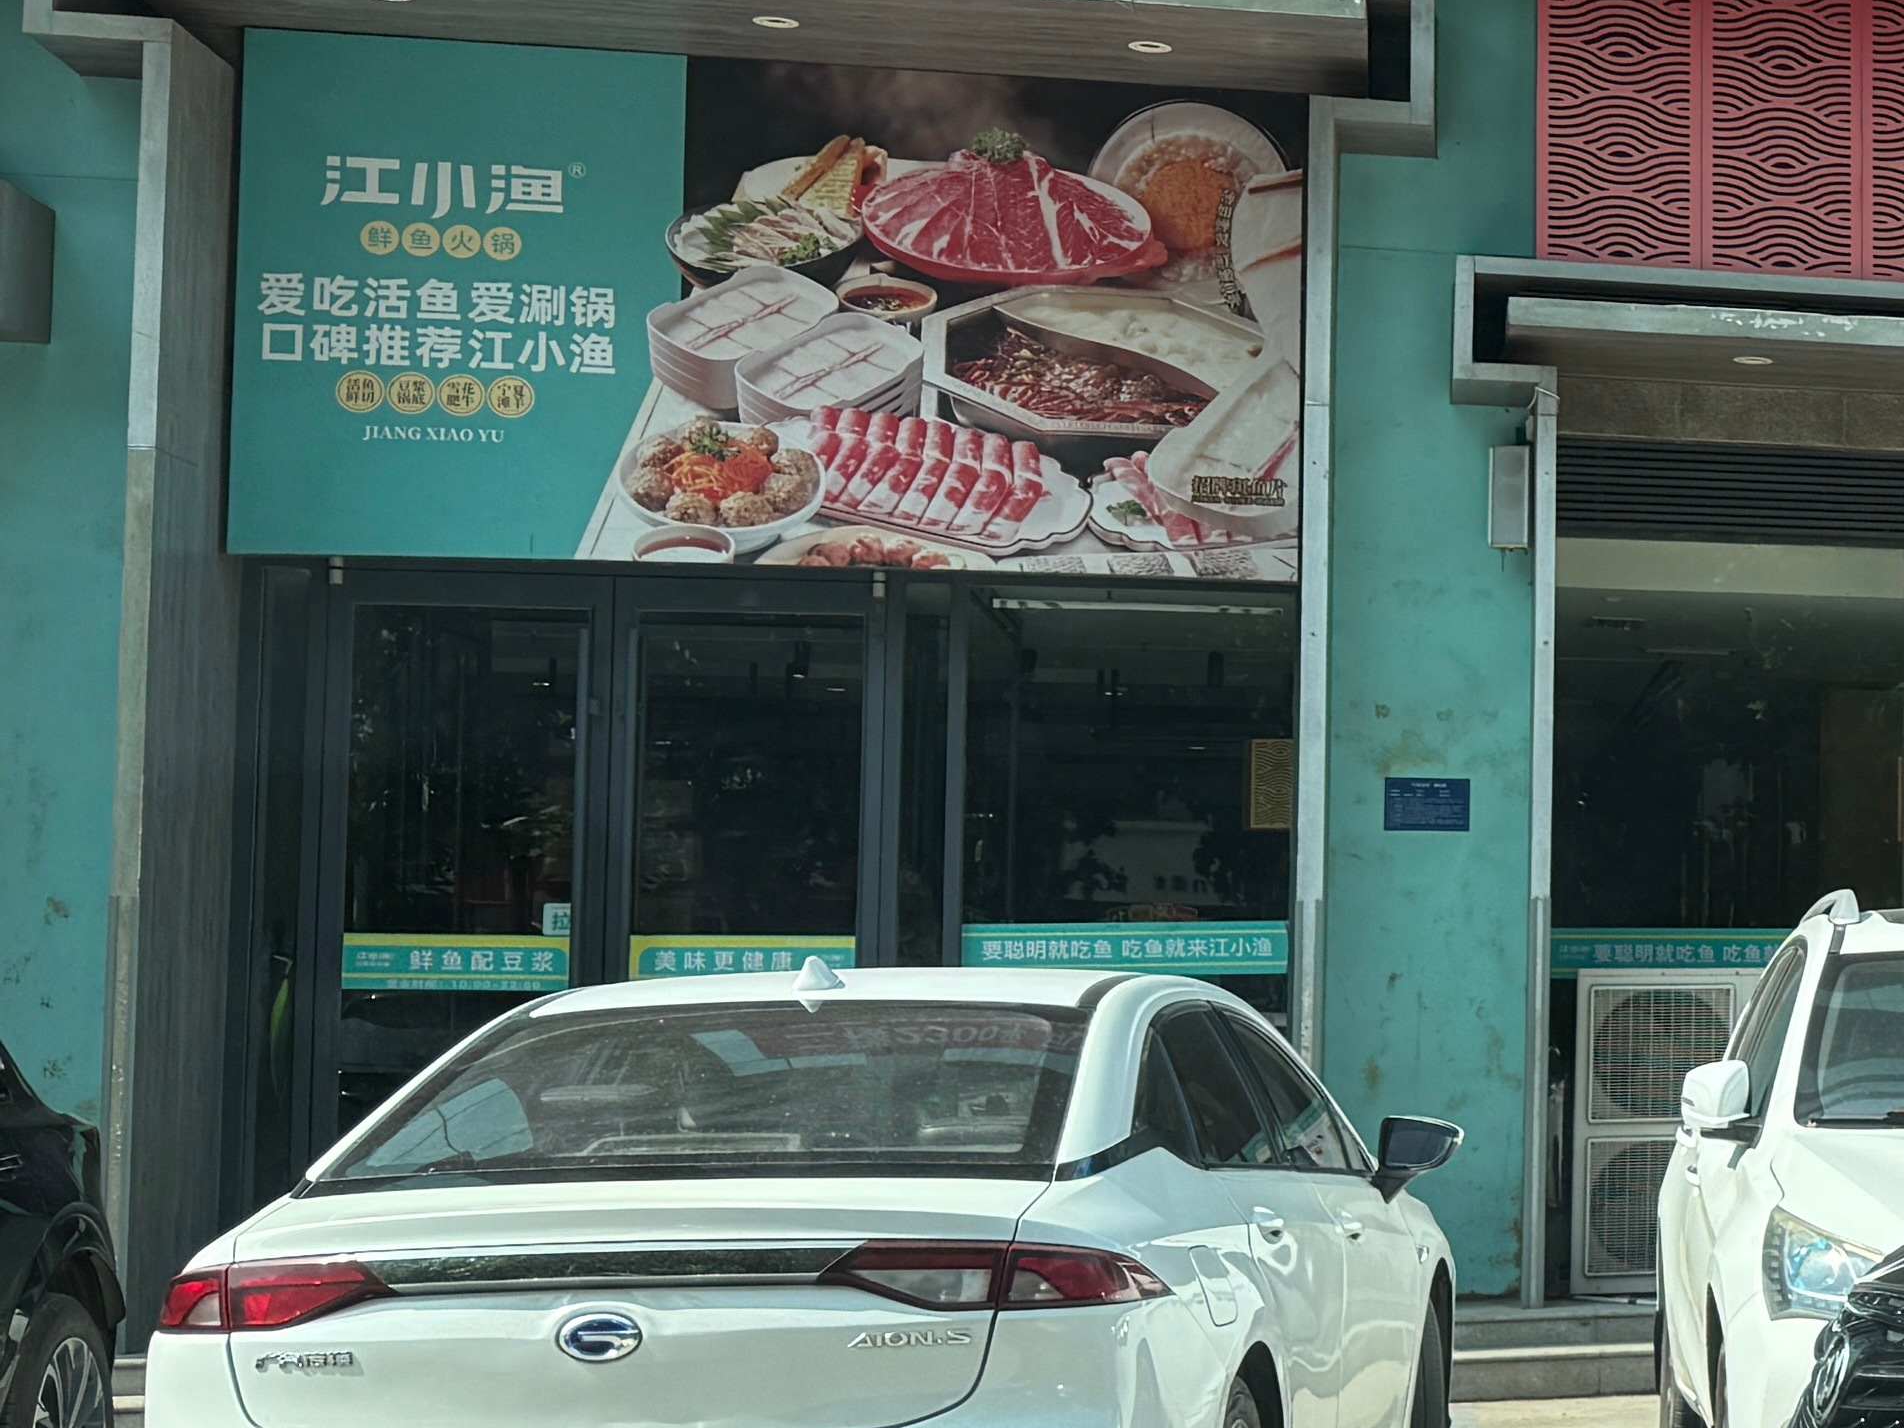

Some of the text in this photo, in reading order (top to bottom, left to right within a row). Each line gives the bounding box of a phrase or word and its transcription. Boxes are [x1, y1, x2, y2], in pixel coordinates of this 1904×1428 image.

[320, 155, 564, 220] 江小渔
[367, 225, 516, 257] 鲜鱼火锅
[256, 272, 617, 330] 爱吃活鱼爱涮锅
[260, 322, 617, 375] 口碑推荐江小渔
[363, 425, 505, 443] JIANG XIAO YU
[409, 950, 554, 973] 鲜鱼配豆浆
[653, 950, 793, 972] 美味更健康
[981, 936, 1273, 961] 要聪明就吃鱼 吃鱼就来江小渔
